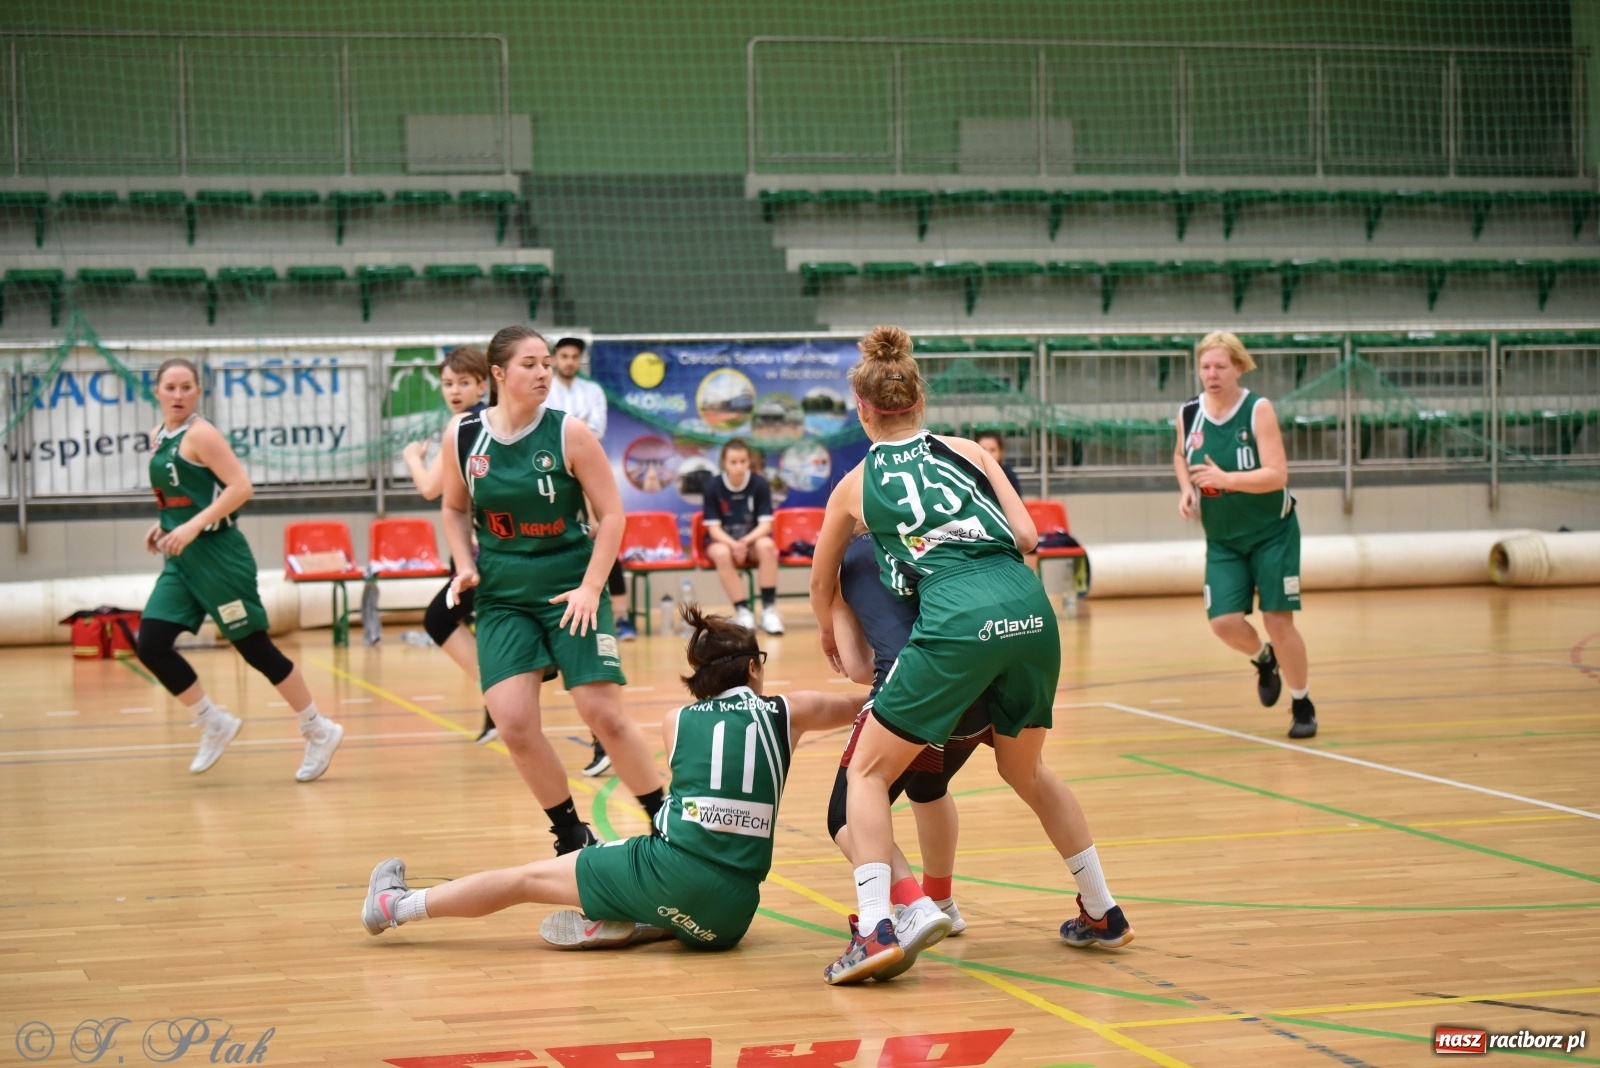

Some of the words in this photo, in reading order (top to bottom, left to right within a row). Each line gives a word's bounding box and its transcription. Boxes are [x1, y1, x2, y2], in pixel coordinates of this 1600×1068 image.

[3, 428, 151, 467] wspiera
[1236, 445, 1255, 471] 10
[165, 462, 180, 487] 3
[537, 474, 556, 504] 4
[880, 463, 962, 535] 35
[994, 613, 1044, 636] Clavis
[710, 720, 759, 794] 11
[699, 804, 751, 816] wydawnictwo
[699, 811, 771, 831] WAGTECH
[671, 913, 717, 942] Clavis
